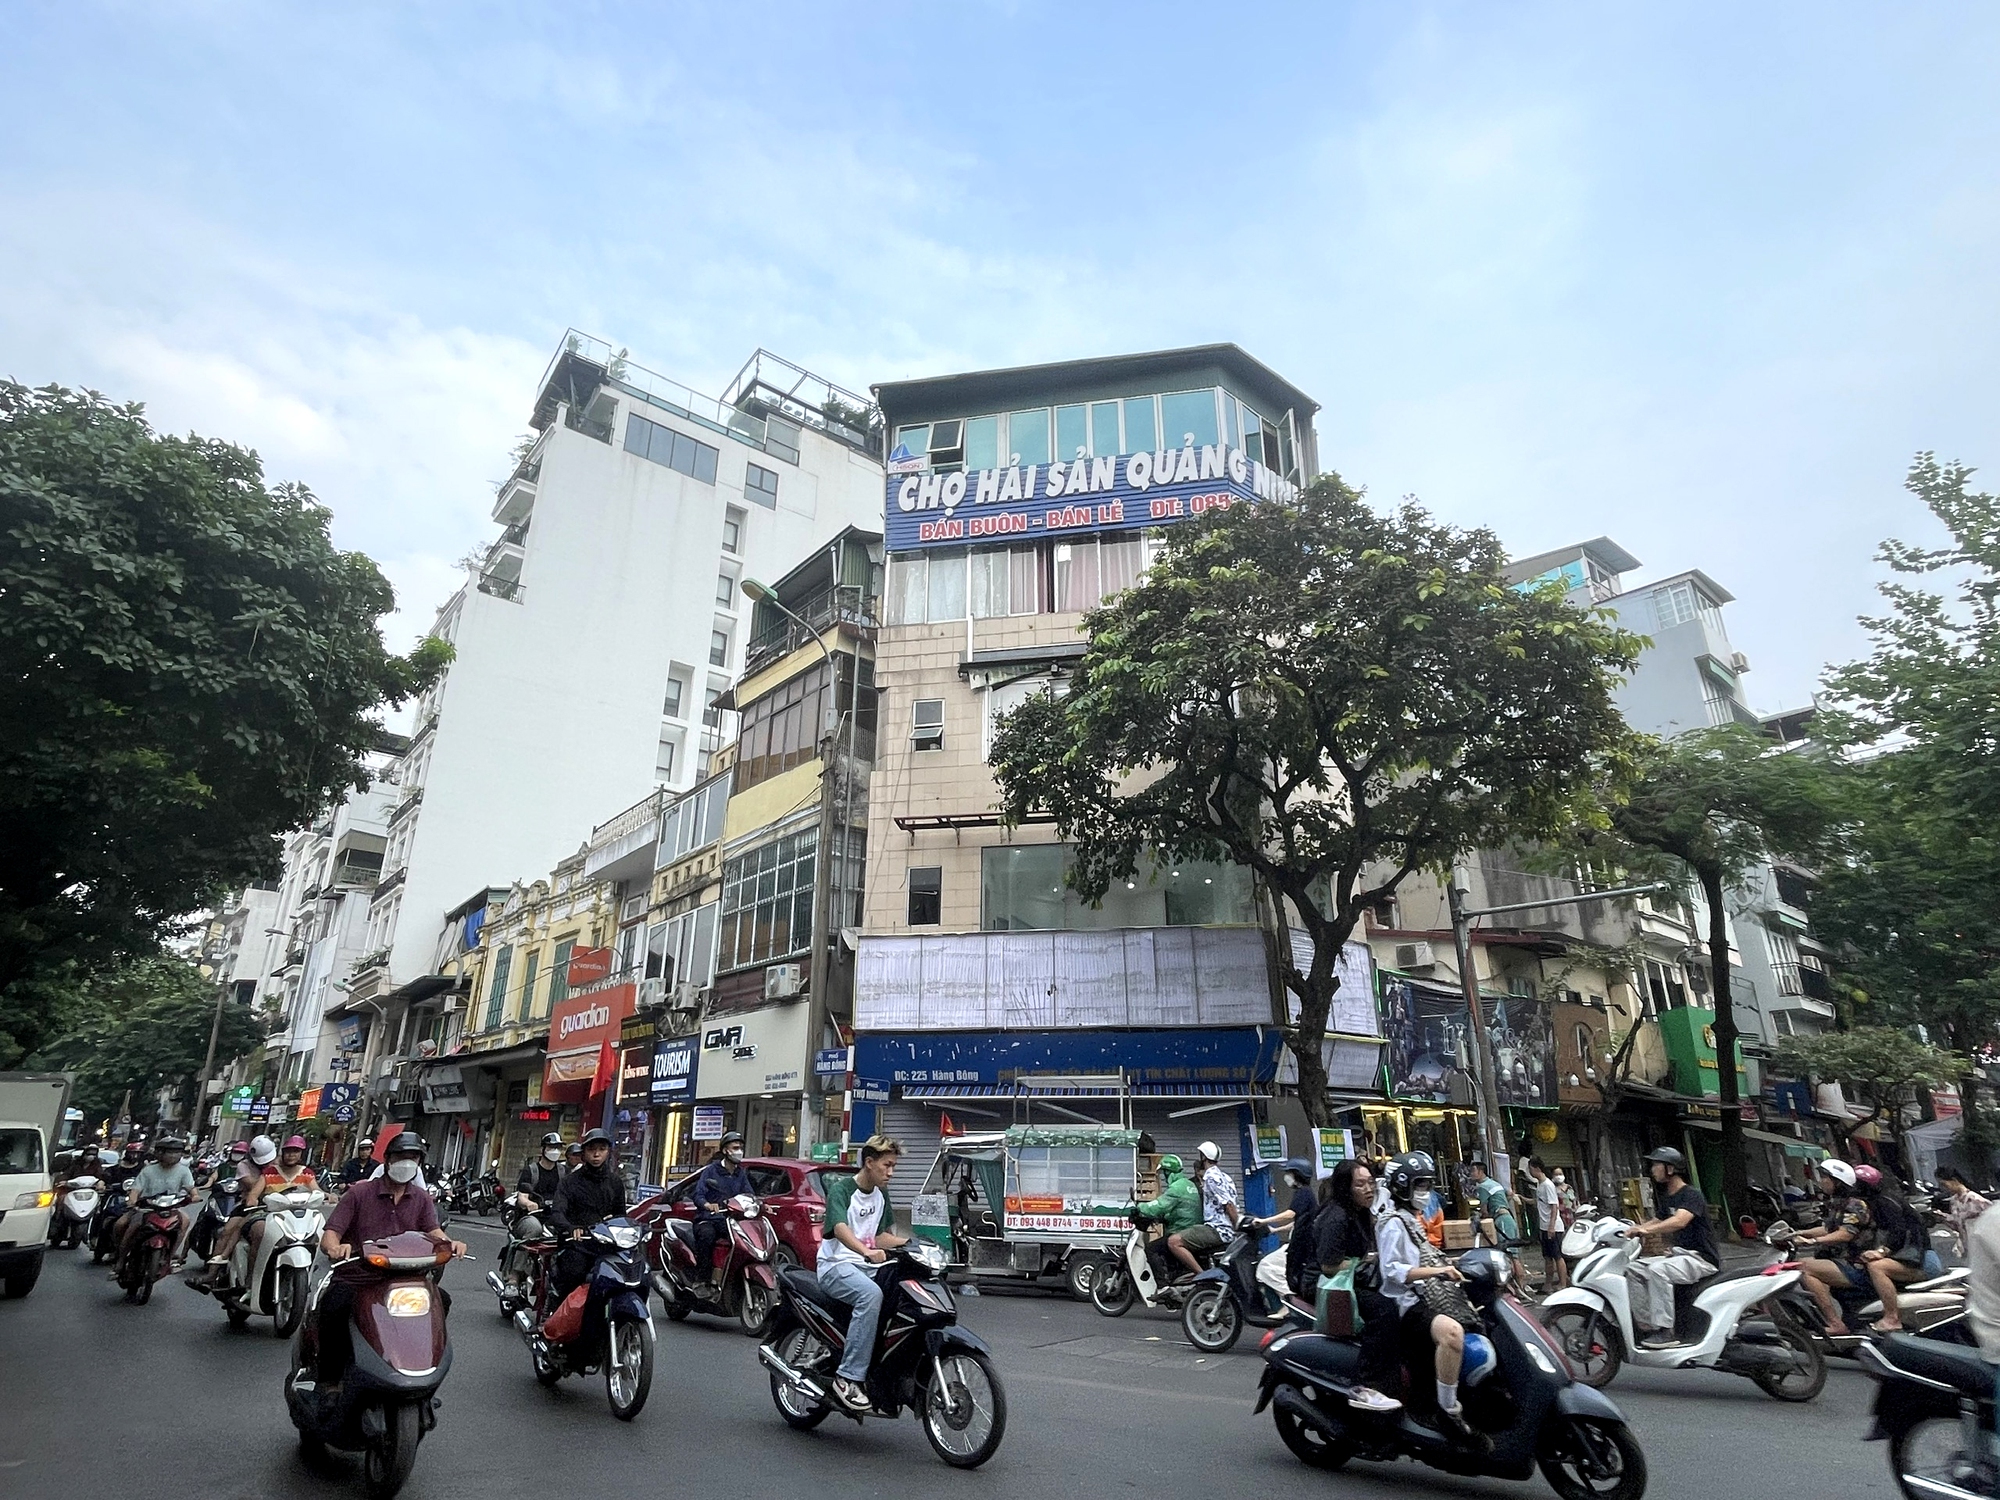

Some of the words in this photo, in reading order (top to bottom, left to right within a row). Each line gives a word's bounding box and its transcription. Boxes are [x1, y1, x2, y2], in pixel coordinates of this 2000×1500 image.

[898, 465, 969, 516] CHỢ
[975, 453, 1037, 504] HẢI
[1045, 445, 1116, 497] SẢN
[1126, 432, 1247, 491] QUẢNG
[920, 518, 963, 542] BÁN
[969, 512, 1027, 537] BUÔN
[1046, 505, 1091, 529] BÁN
[1099, 499, 1124, 524] LẺ
[1150, 498, 1184, 519] ĐT:
[560, 1003, 610, 1040] guardian
[653, 1049, 692, 1078] TOURISM
[911, 1070, 927, 1081] 225
[932, 1069, 954, 1082] Hàng
[956, 1069, 979, 1082] Bông
[1020, 1217, 1034, 1227] 093
[1037, 1217, 1051, 1227] 448
[1053, 1217, 1072, 1227] 8744
[1097, 1218, 1111, 1228] 269
